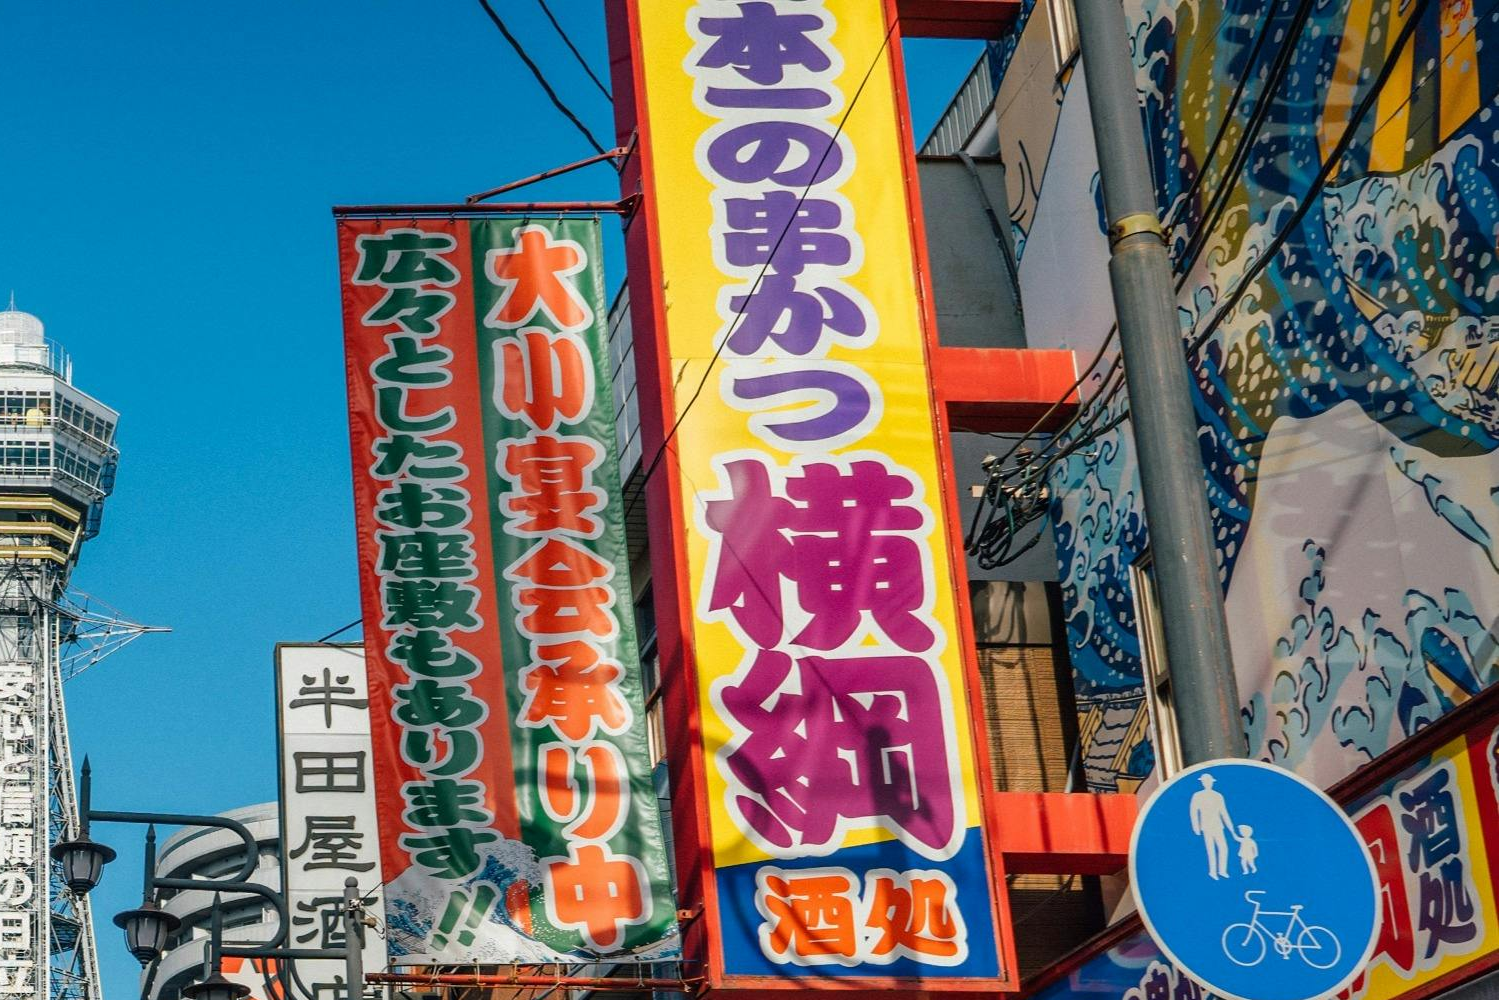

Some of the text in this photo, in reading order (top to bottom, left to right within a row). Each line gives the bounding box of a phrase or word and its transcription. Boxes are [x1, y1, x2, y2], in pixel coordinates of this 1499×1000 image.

[490, 226, 643, 948] 大小宴会承り中
[706, 460, 954, 850] 横綱
[763, 876, 959, 959] 酒処
[1399, 768, 1477, 960] 酒処
